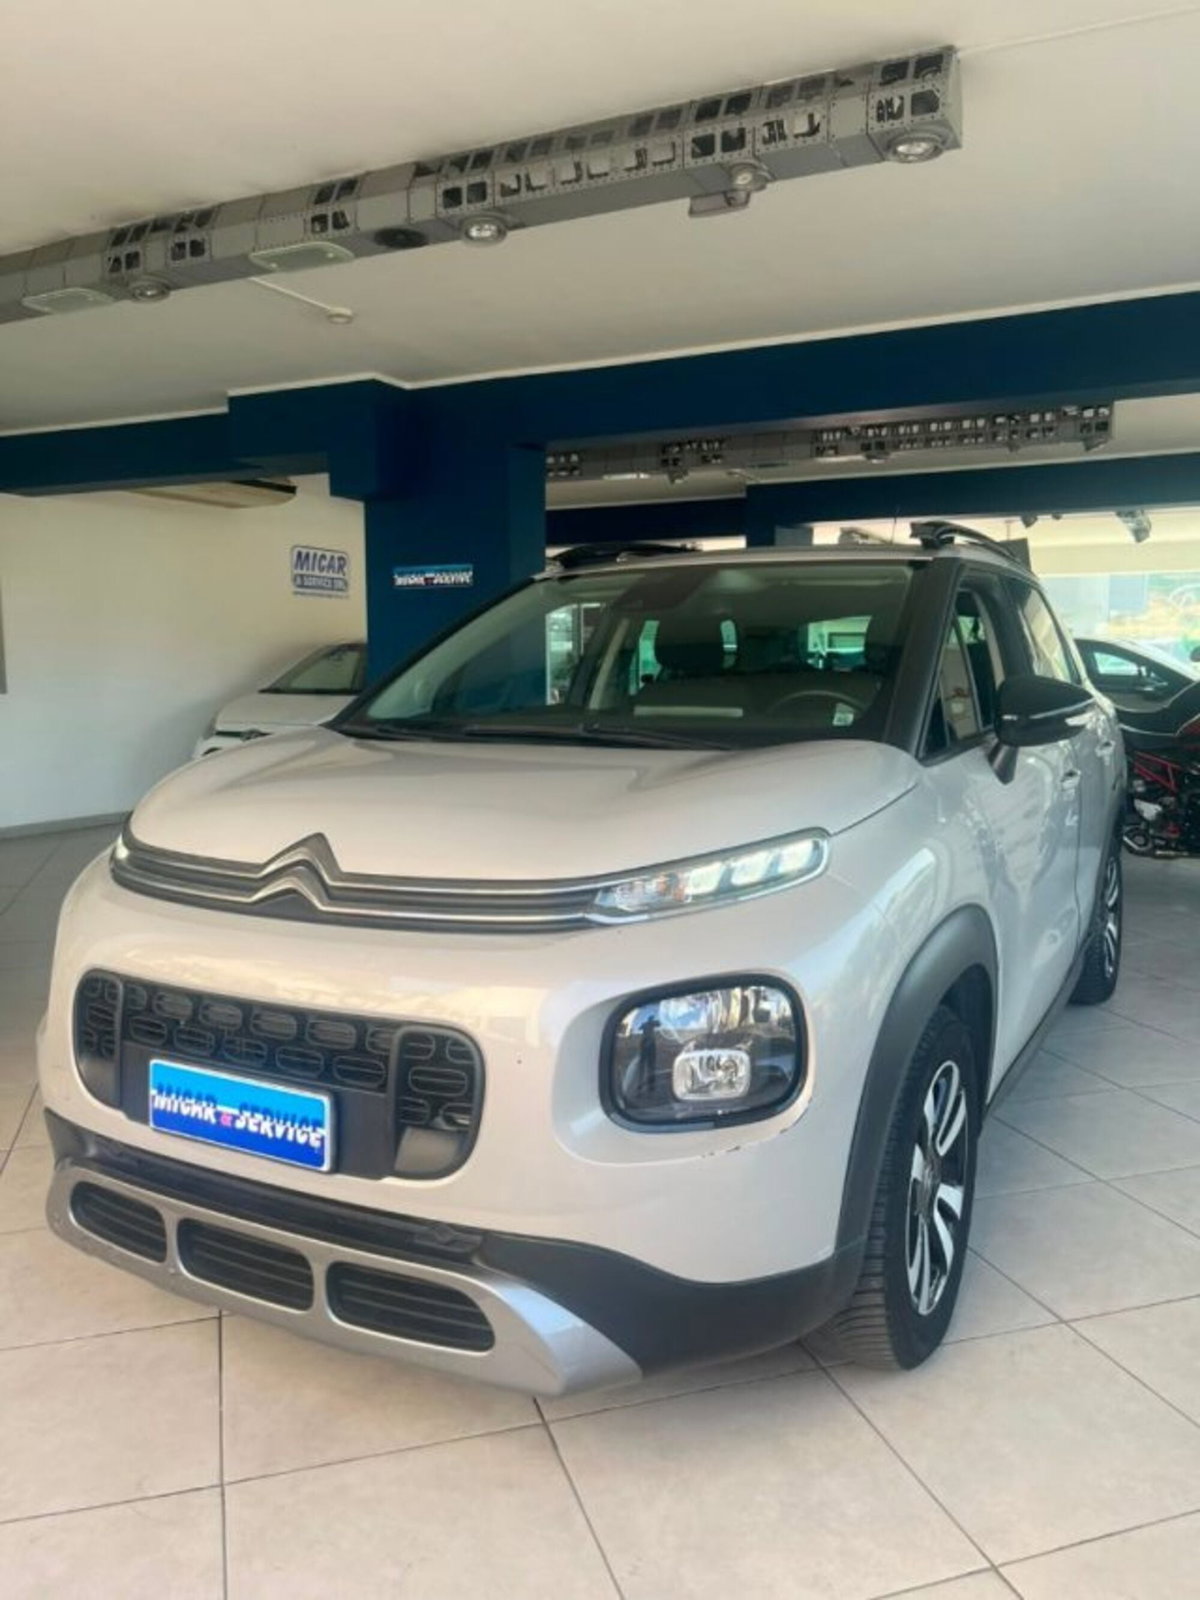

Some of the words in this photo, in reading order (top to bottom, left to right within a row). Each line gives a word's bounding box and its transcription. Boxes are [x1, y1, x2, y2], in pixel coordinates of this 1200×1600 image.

[294, 550, 346, 576] MICAR
[153, 1082, 217, 1125] MICAR
[234, 1102, 324, 1149] SERVICE
